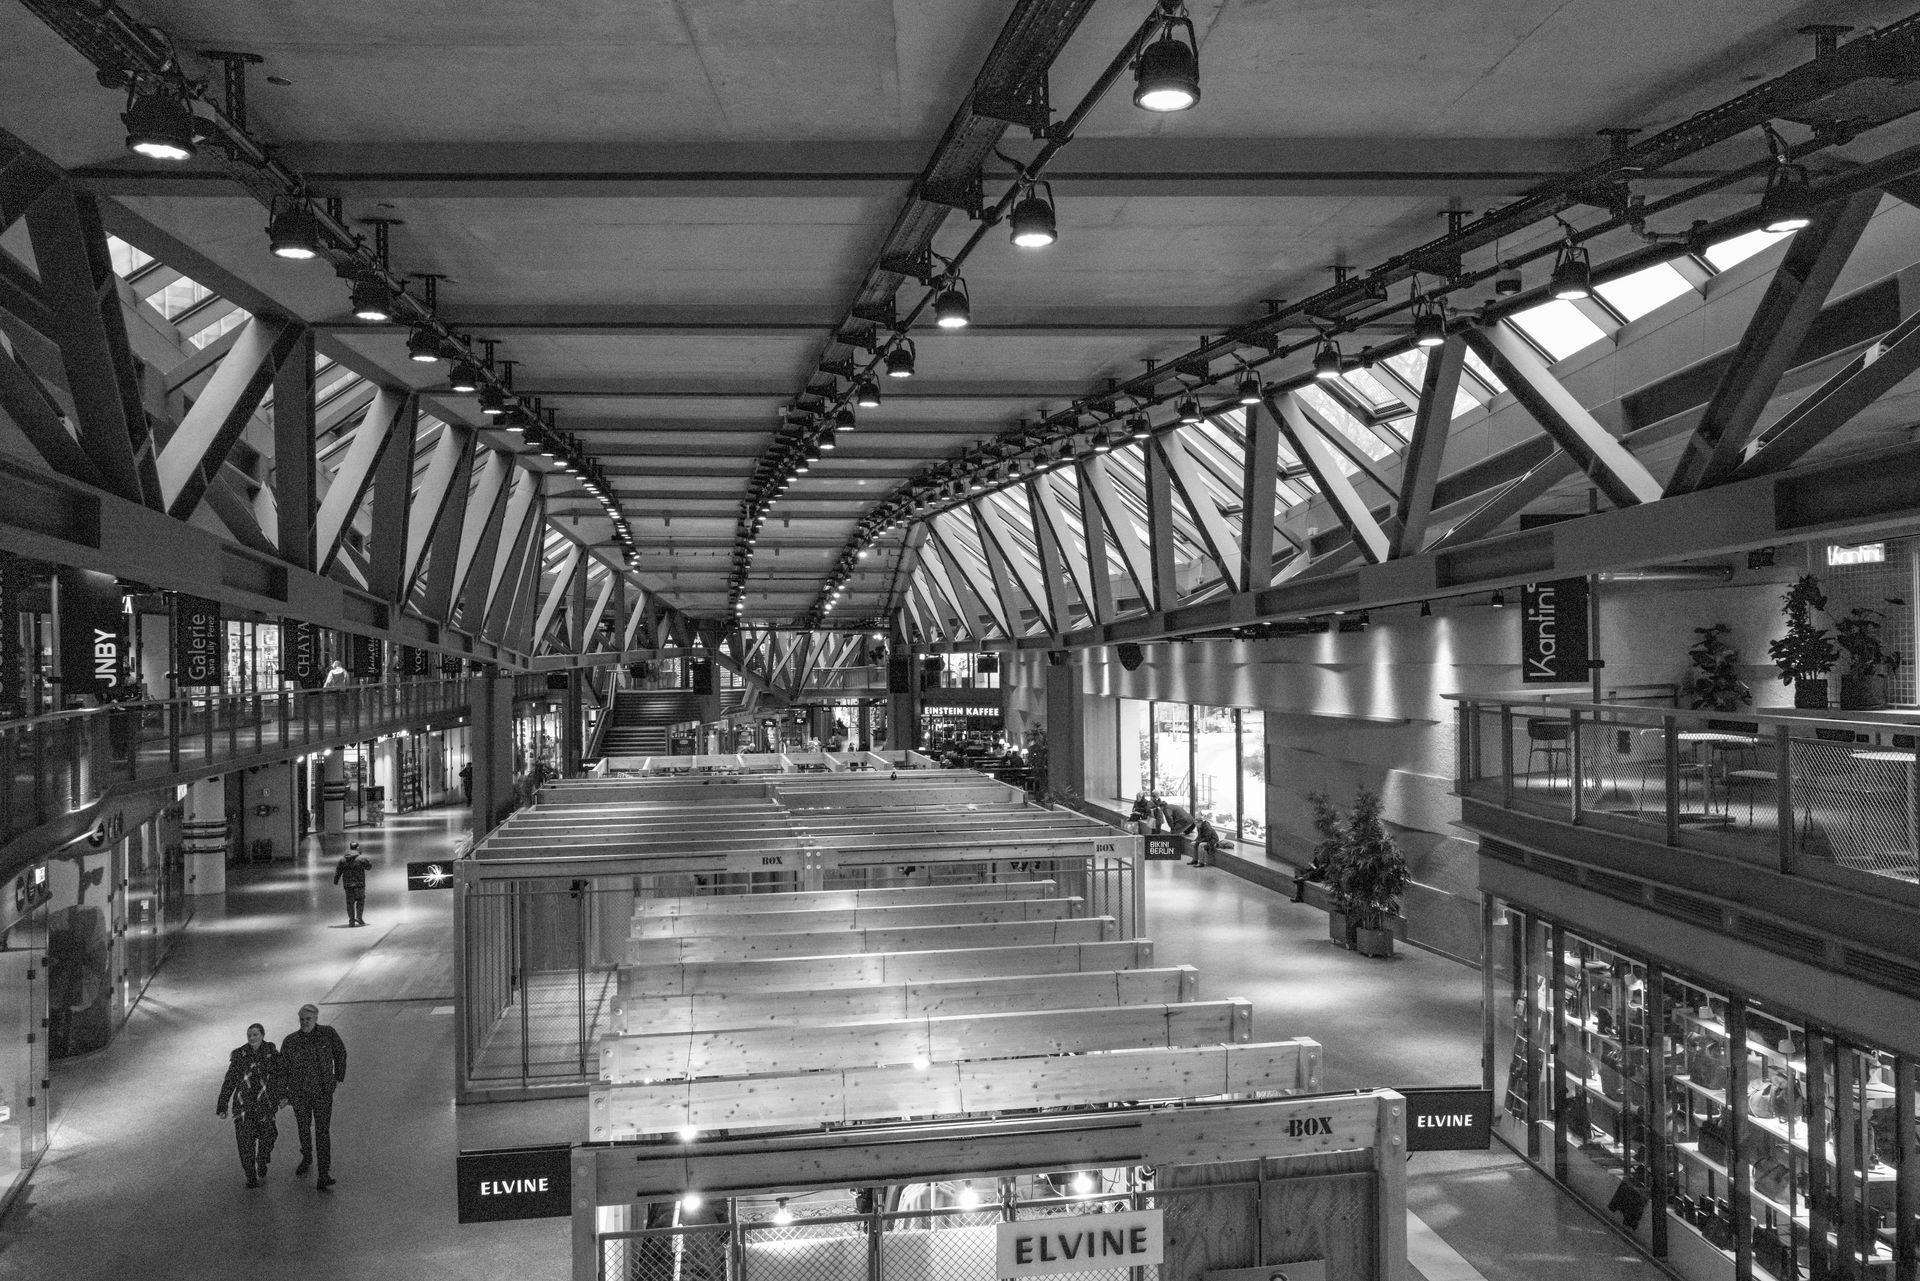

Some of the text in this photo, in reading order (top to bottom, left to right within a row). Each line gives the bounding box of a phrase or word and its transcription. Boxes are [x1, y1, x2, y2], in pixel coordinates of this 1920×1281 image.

[1527, 584, 1556, 677] Kantini
[187, 613, 206, 680] Galerie
[207, 640, 217, 655] Lily
[297, 622, 310, 677] CHAYA
[94, 628, 117, 688] JNBY
[207, 658, 216, 676] Sara
[924, 706, 1000, 717] EINSTEIN KAFFEE
[1096, 843, 1115, 852] BOX
[1149, 847, 1175, 855] BERLIN
[762, 856, 783, 865] BOX
[1288, 1116, 1334, 1138] BOX
[1417, 1114, 1474, 1128] ELVINE
[480, 1178, 549, 1195] ELVINE
[1016, 1227, 1147, 1264] ELVINE
